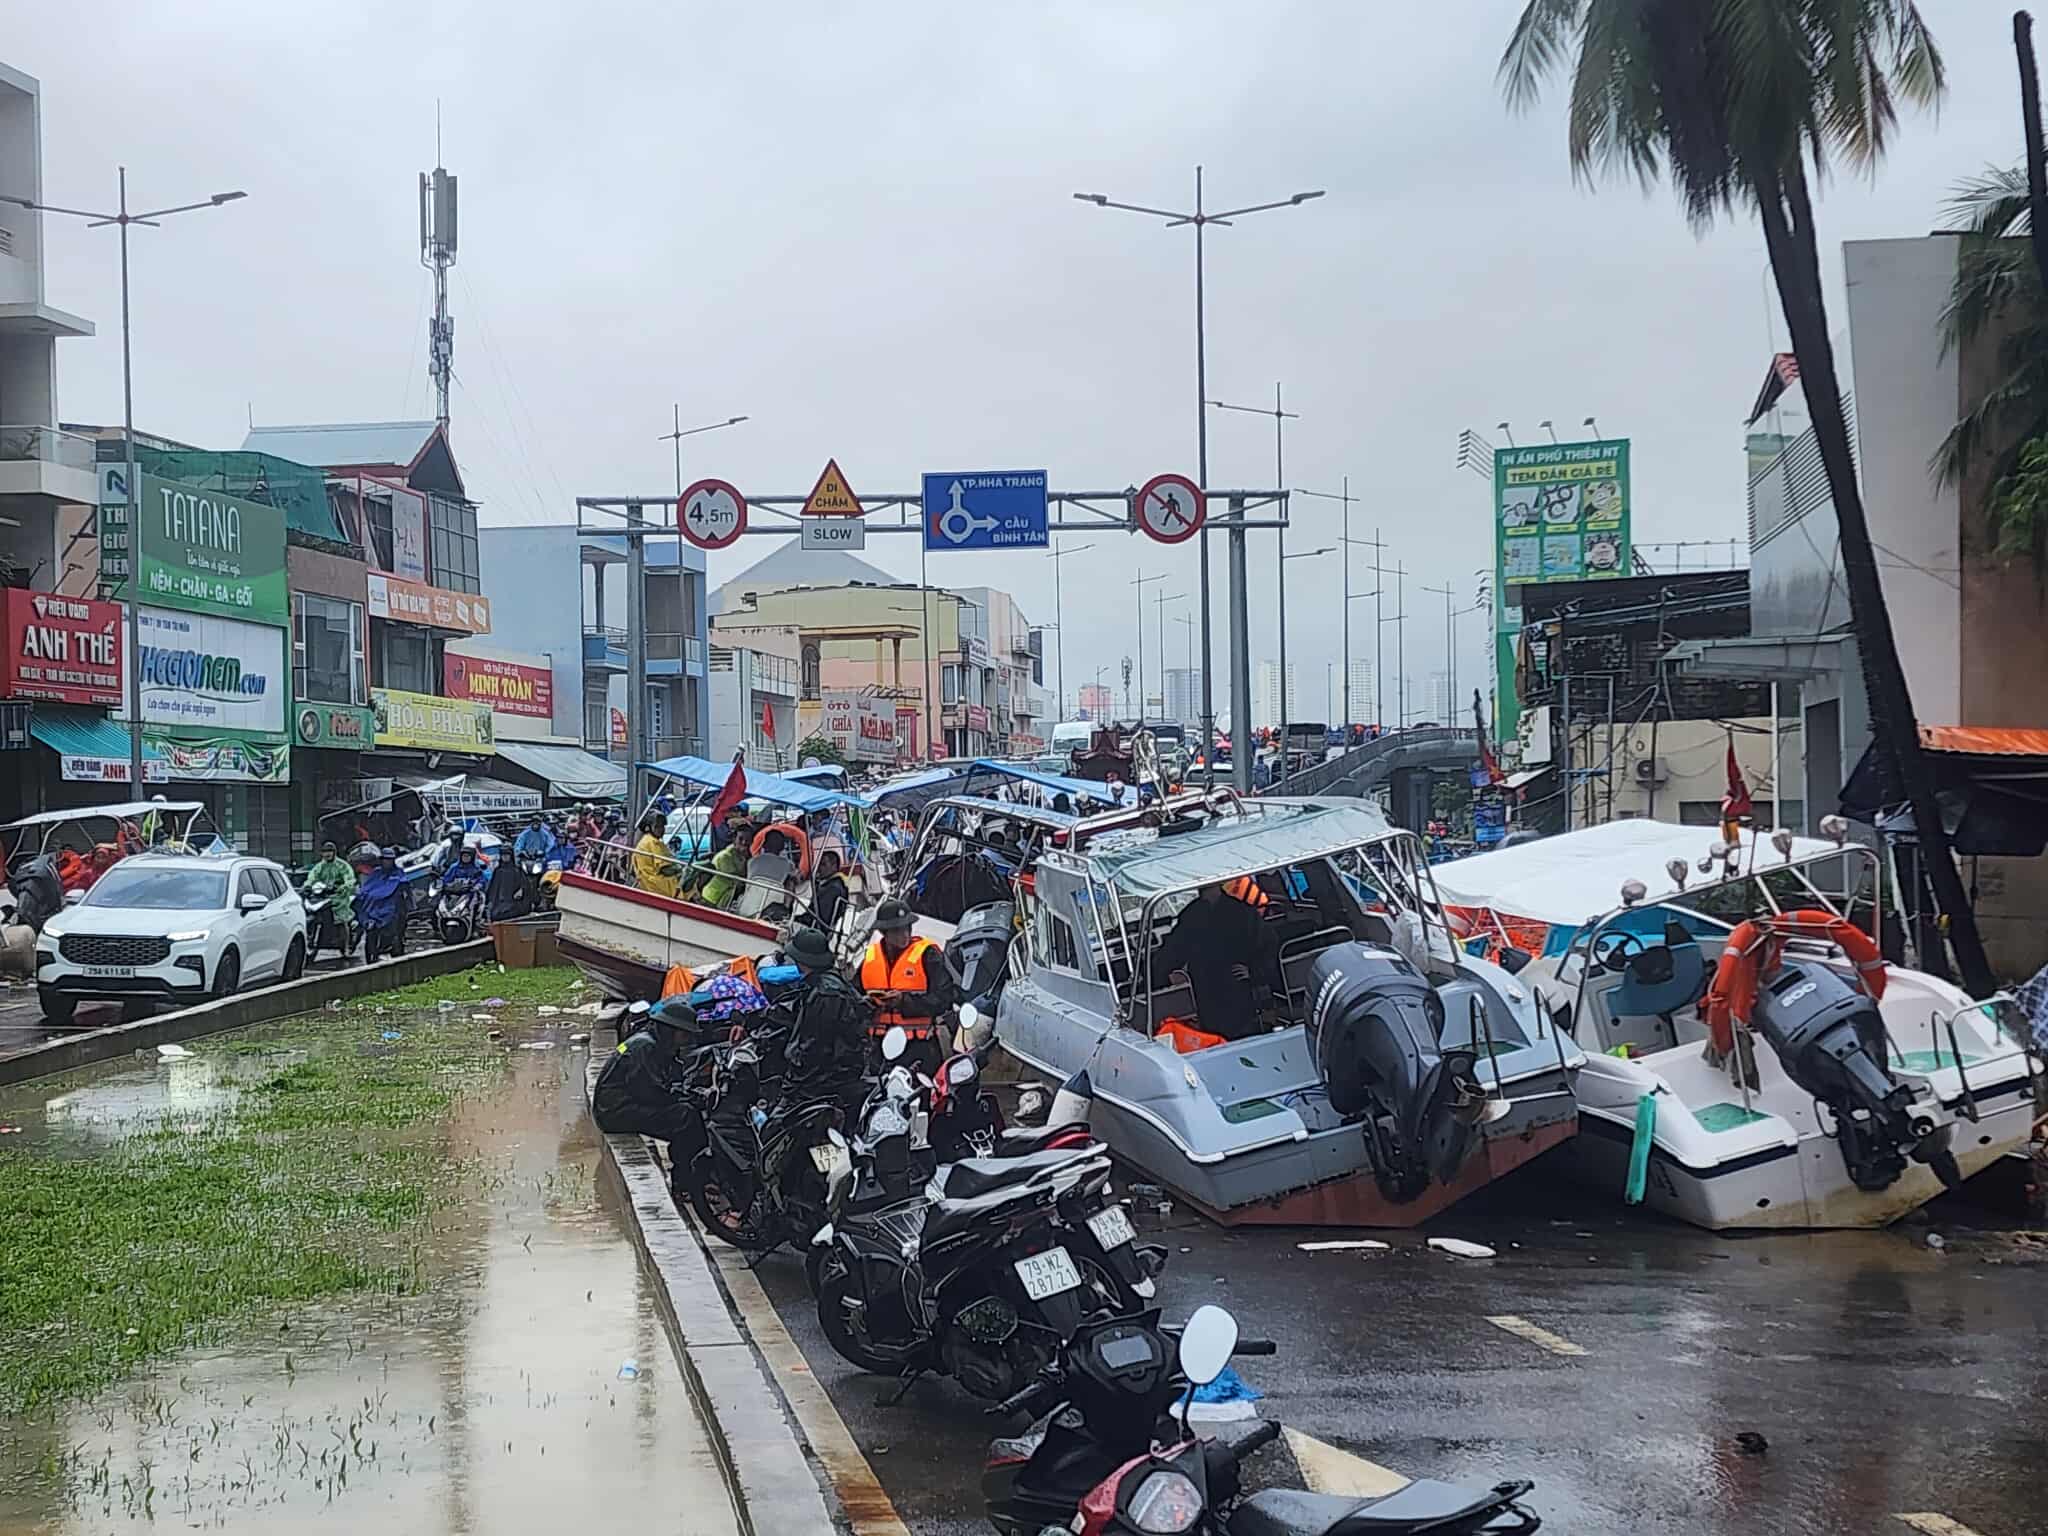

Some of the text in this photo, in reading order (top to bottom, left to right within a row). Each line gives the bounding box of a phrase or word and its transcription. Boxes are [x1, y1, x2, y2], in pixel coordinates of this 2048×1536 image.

[1005, 477, 1044, 487] TRANG
[1510, 471, 1537, 482] TEM
[160, 487, 241, 554] TATANA
[813, 528, 852, 540] SLOW
[993, 533, 1021, 544] BÌNH
[215, 584, 229, 604] GA
[23, 625, 68, 661] ANH
[74, 620, 116, 665] THẾ
[469, 672, 500, 698] MINH
[103, 763, 126, 779] ANH
